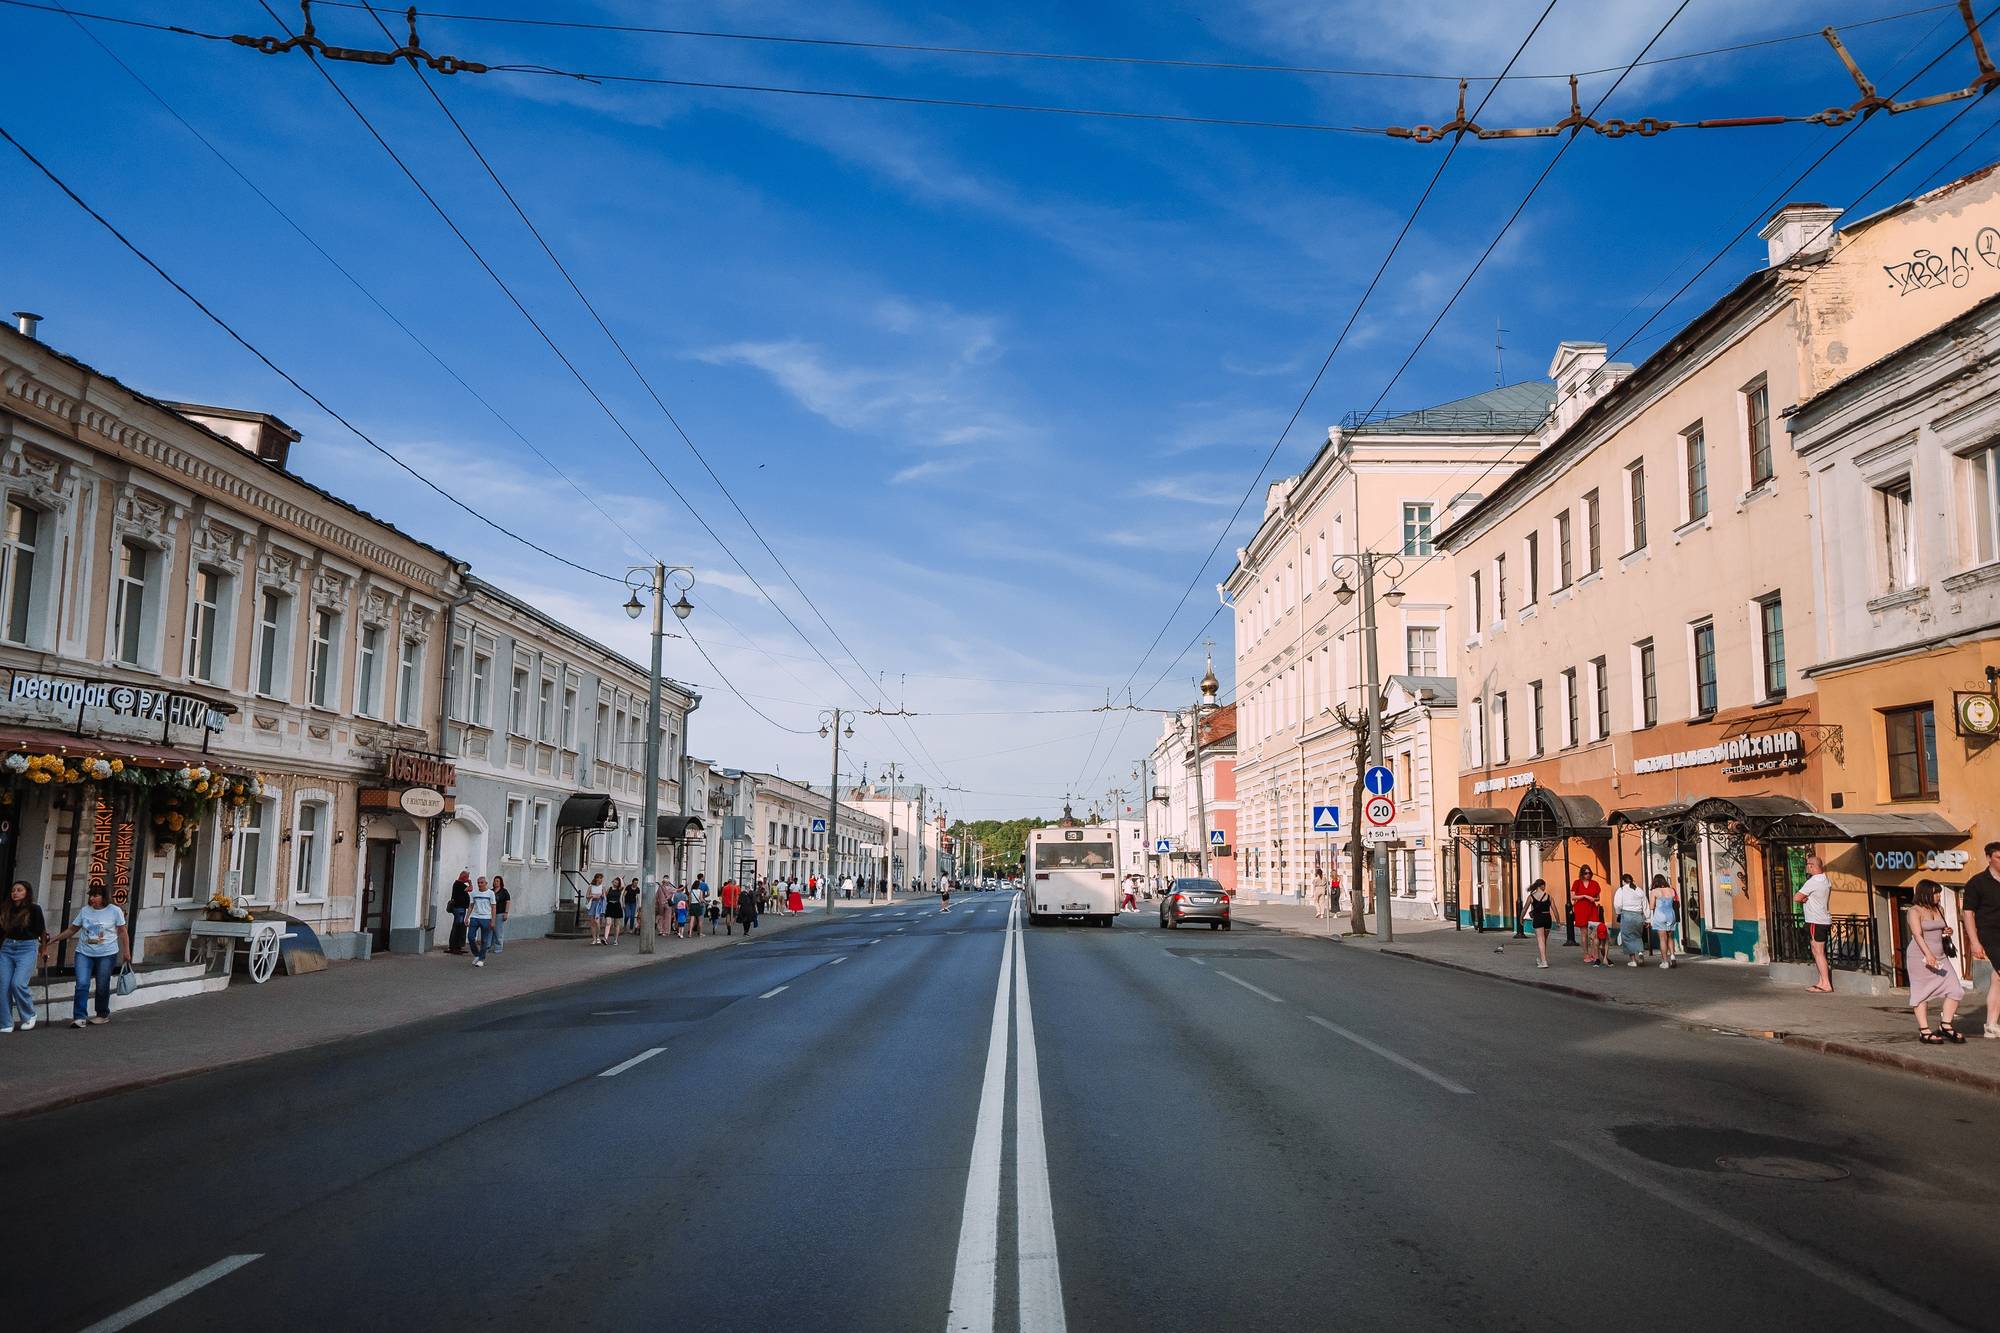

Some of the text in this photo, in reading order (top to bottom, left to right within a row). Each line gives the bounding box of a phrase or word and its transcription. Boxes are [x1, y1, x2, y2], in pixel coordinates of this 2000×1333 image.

[11, 675, 107, 710] ресторан
[112, 687, 207, 728] ФРАНКИ
[1721, 763, 1755, 775] РЕСТОРАН
[1783, 758, 1798, 768] БАР
[1373, 805, 1389, 817] 20
